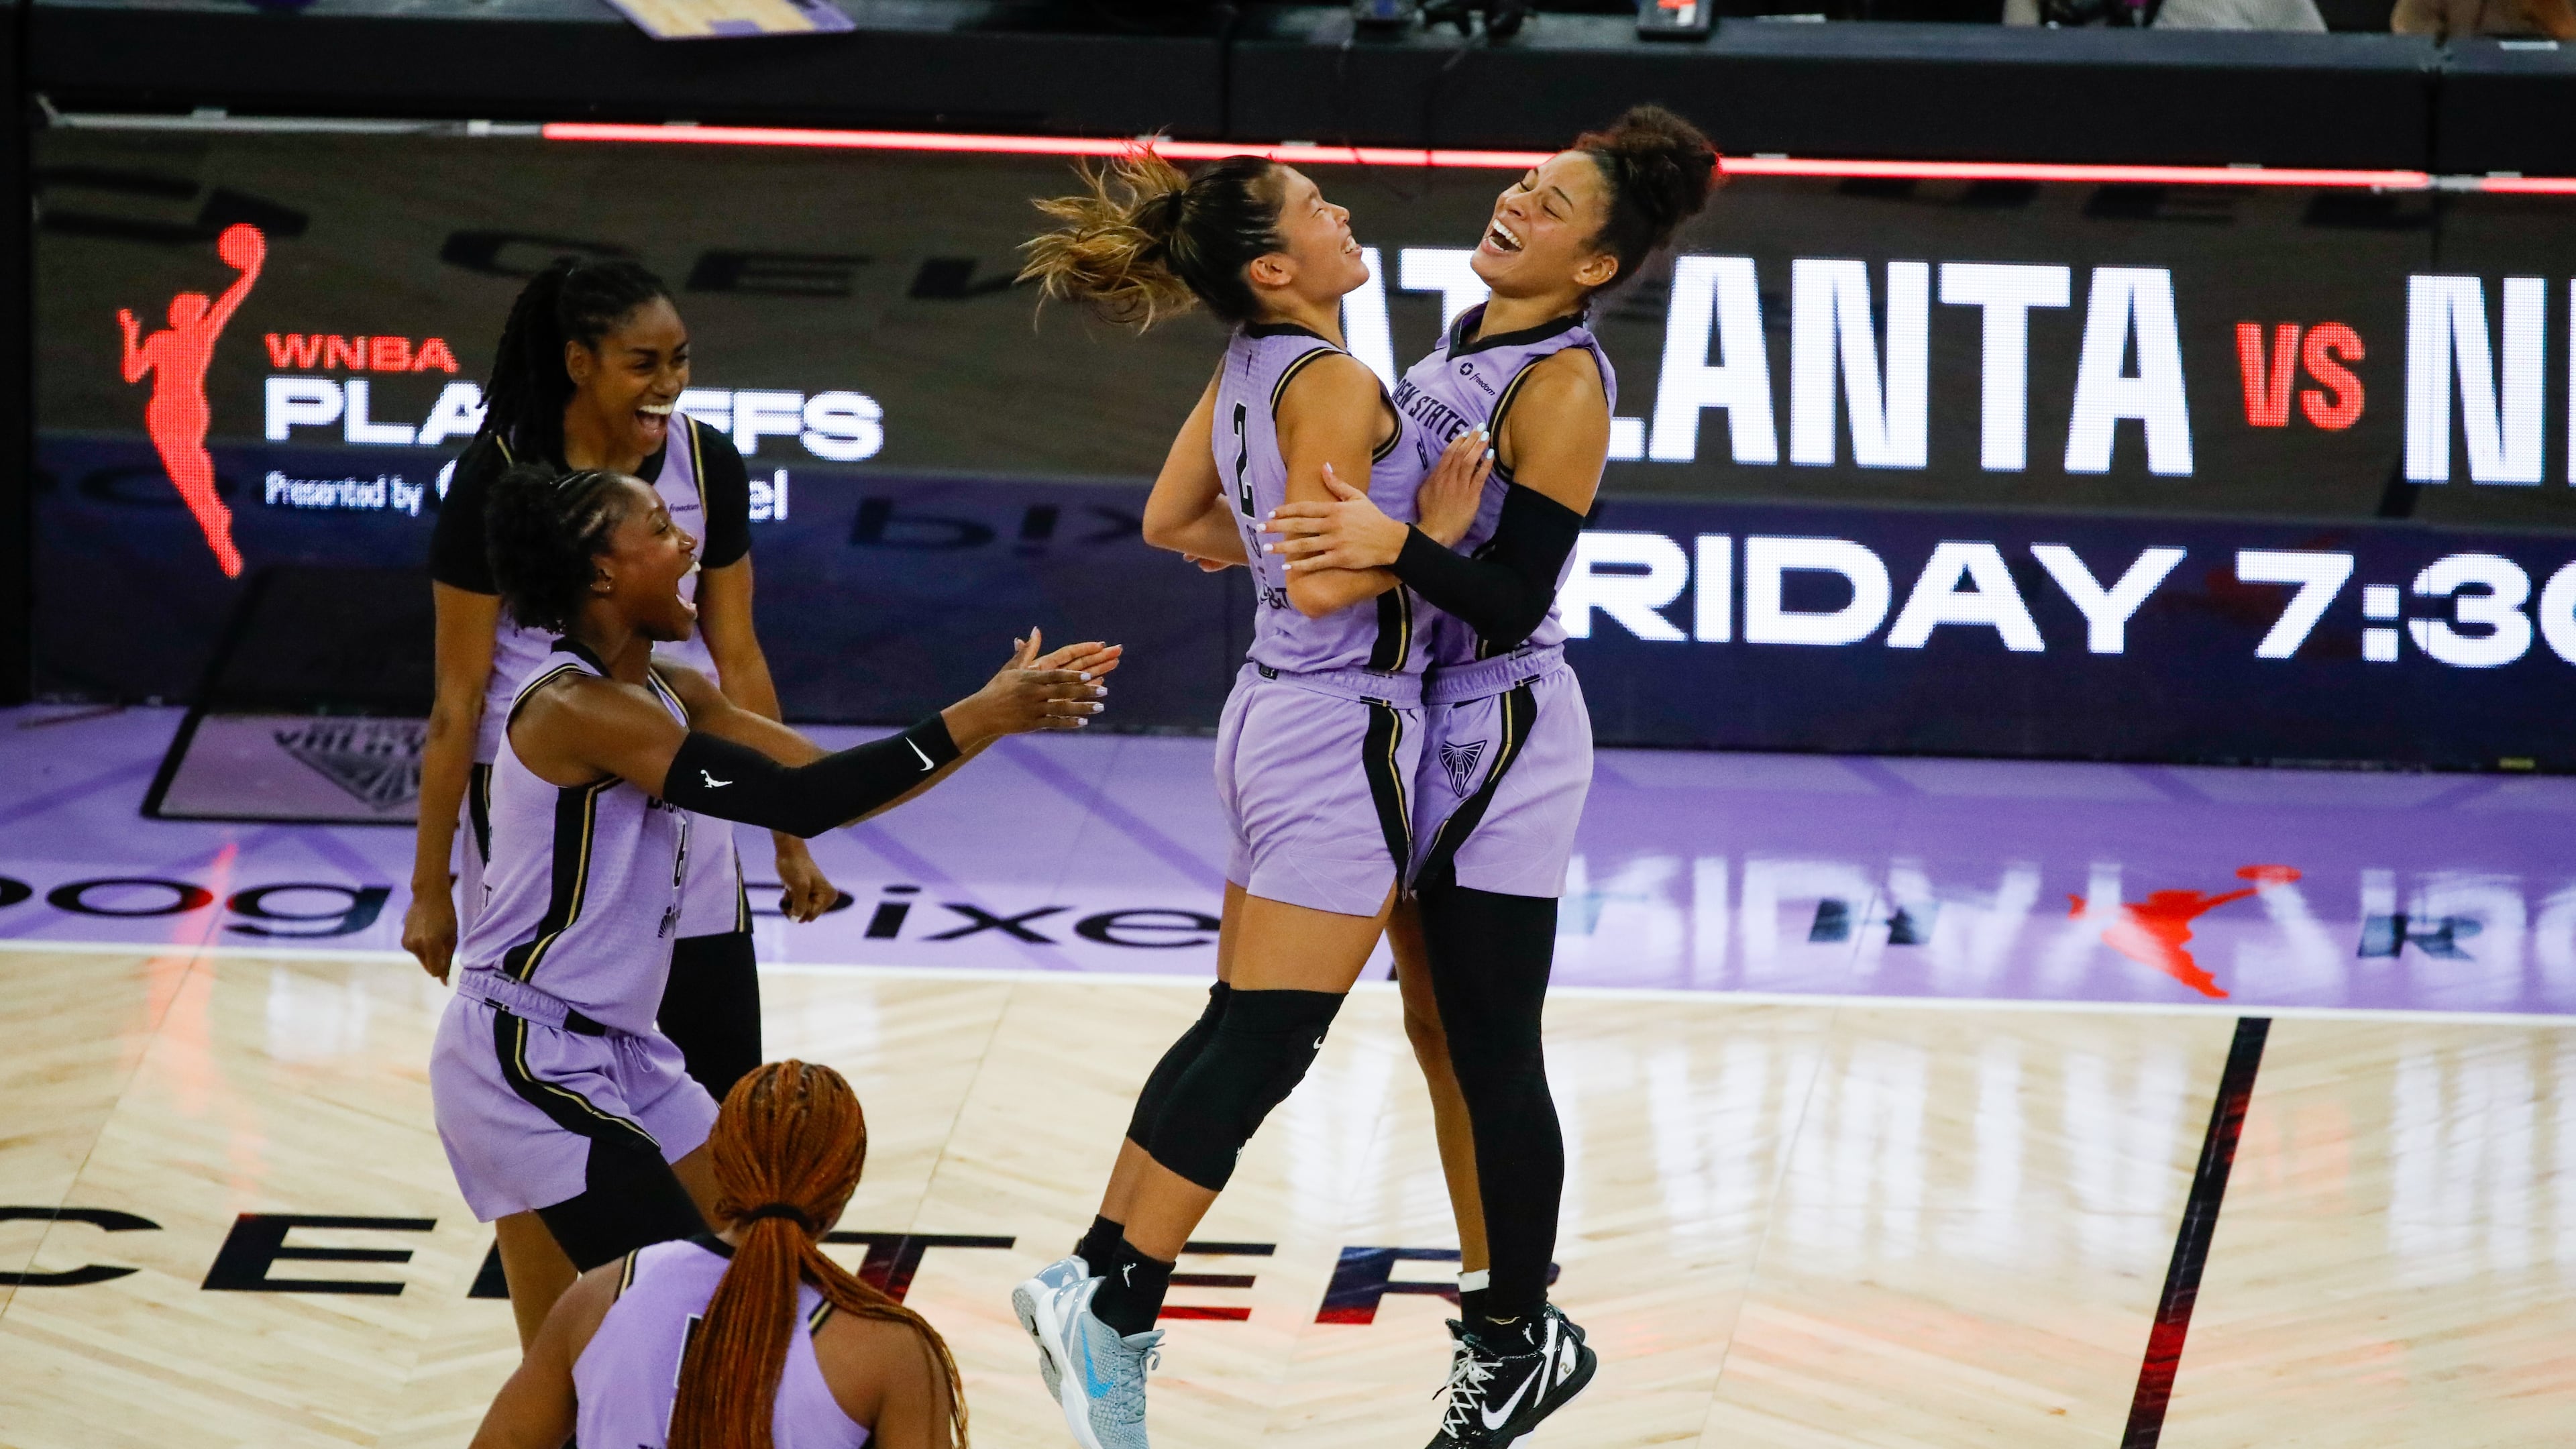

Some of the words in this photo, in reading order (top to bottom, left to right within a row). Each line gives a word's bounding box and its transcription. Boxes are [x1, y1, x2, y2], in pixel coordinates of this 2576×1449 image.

[265, 333, 460, 373] WNBA
[1469, 373, 1495, 396] freedom
[2403, 275, 2576, 487] N
[1407, 396, 1470, 444] STATE
[1232, 400, 1256, 519] 2
[265, 470, 387, 508] Presented
[390, 474, 423, 517] by
[668, 502, 699, 516] freedom
[1560, 533, 2188, 653] RIDAY
[2235, 549, 2576, 668] 7:3
